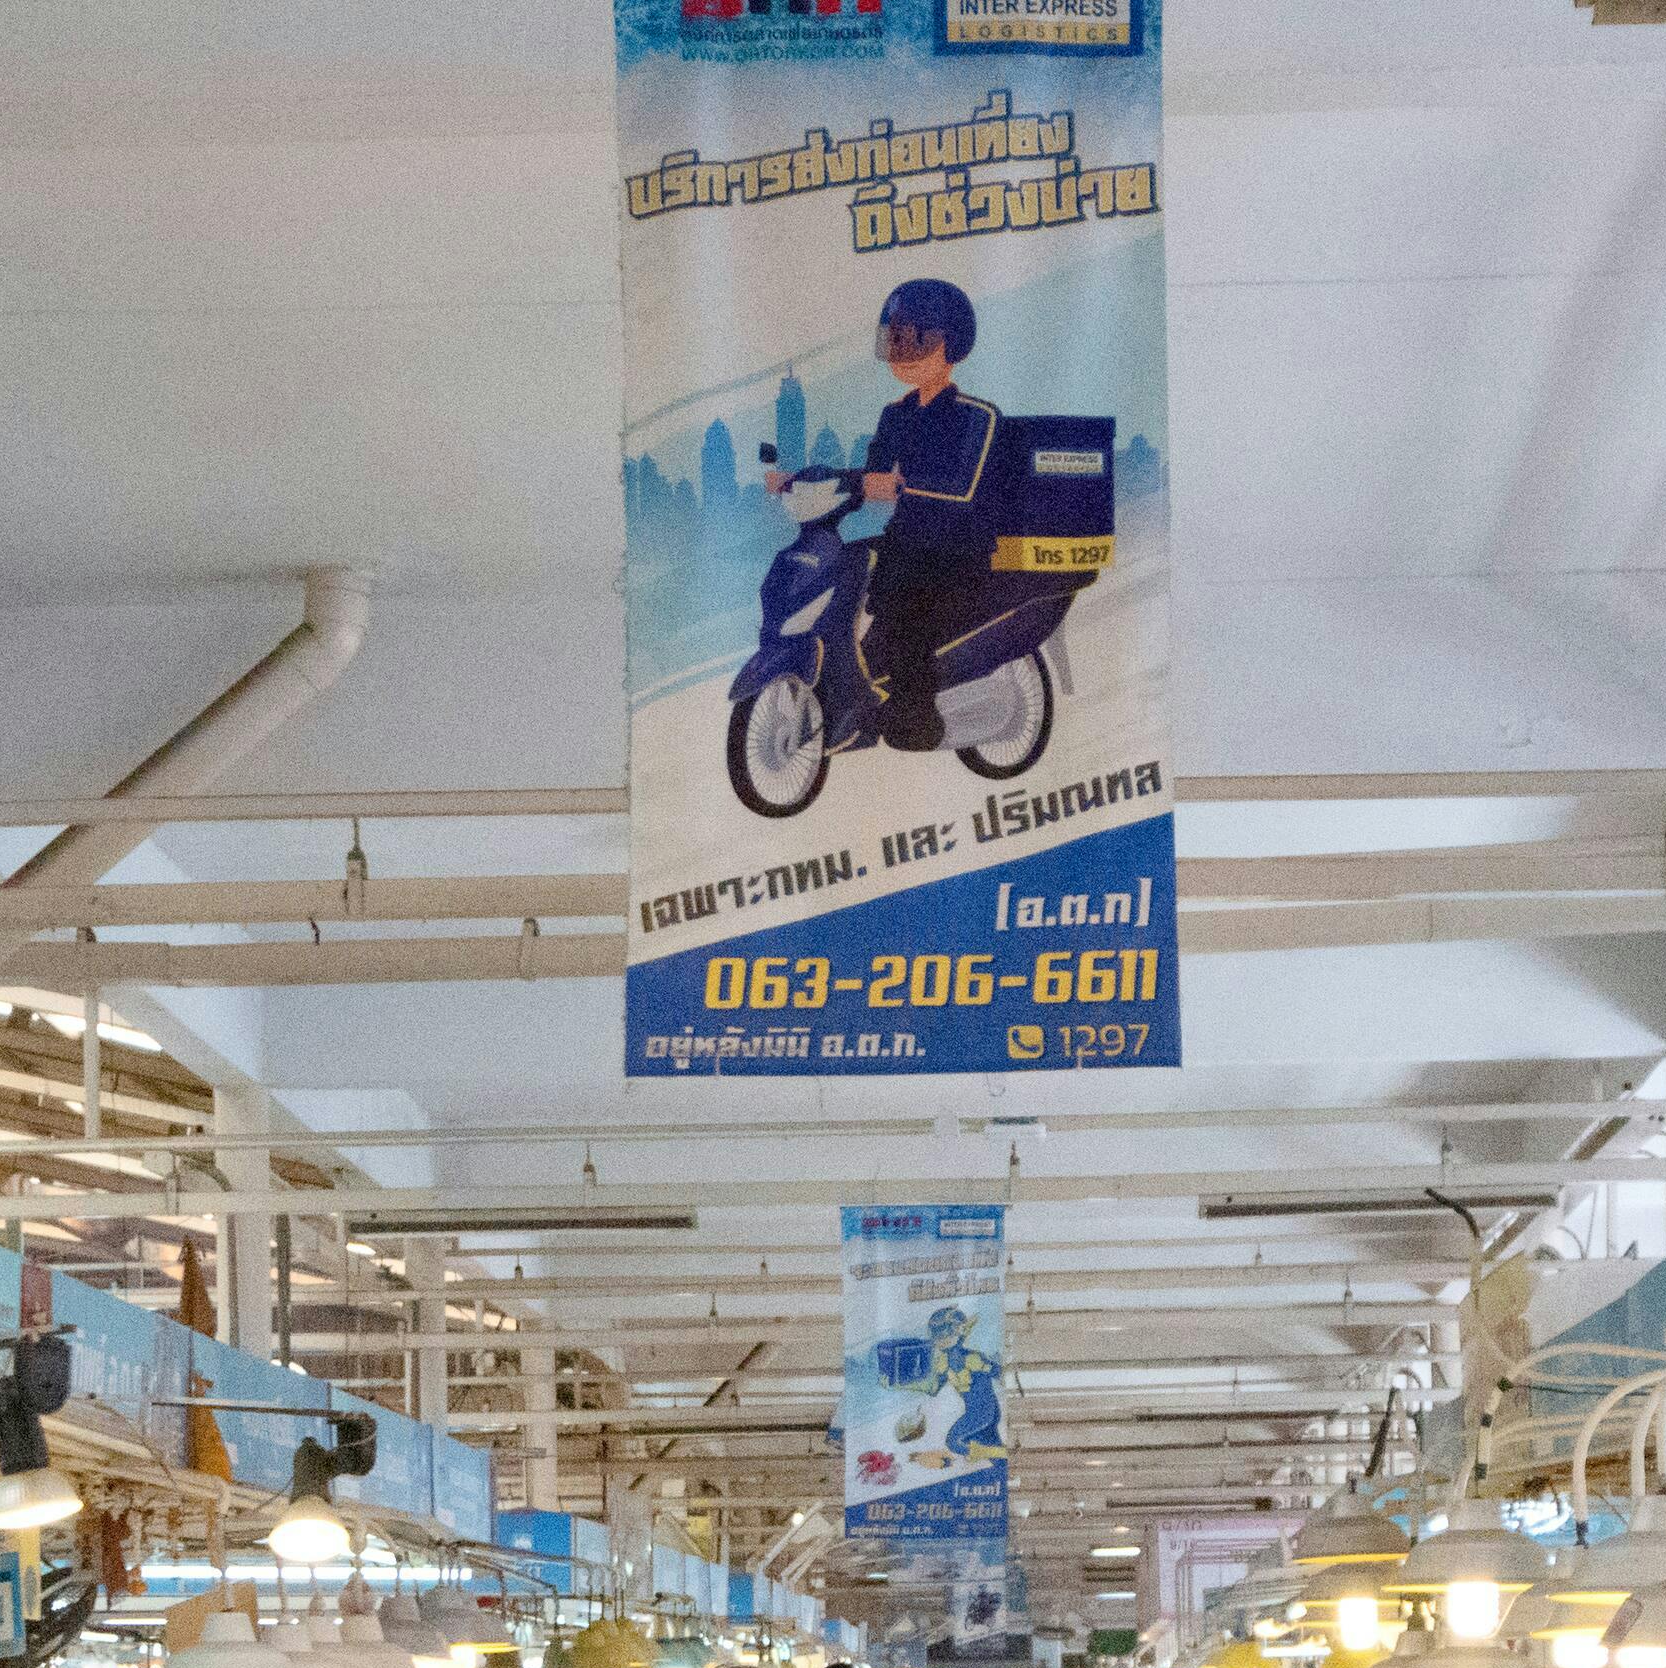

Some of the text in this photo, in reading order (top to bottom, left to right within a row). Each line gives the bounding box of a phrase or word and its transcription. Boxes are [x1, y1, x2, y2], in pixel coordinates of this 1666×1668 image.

[959, 0, 1118, 17] INTER EXPRESS
[627, 89, 1076, 220] บริการส่งก่อนเที่ยง
[1033, 544, 1111, 564] โทร 1297
[882, 821, 958, 869] และ
[704, 948, 1160, 1011] 063-206-6611
[1057, 1024, 1150, 1058] 1297
